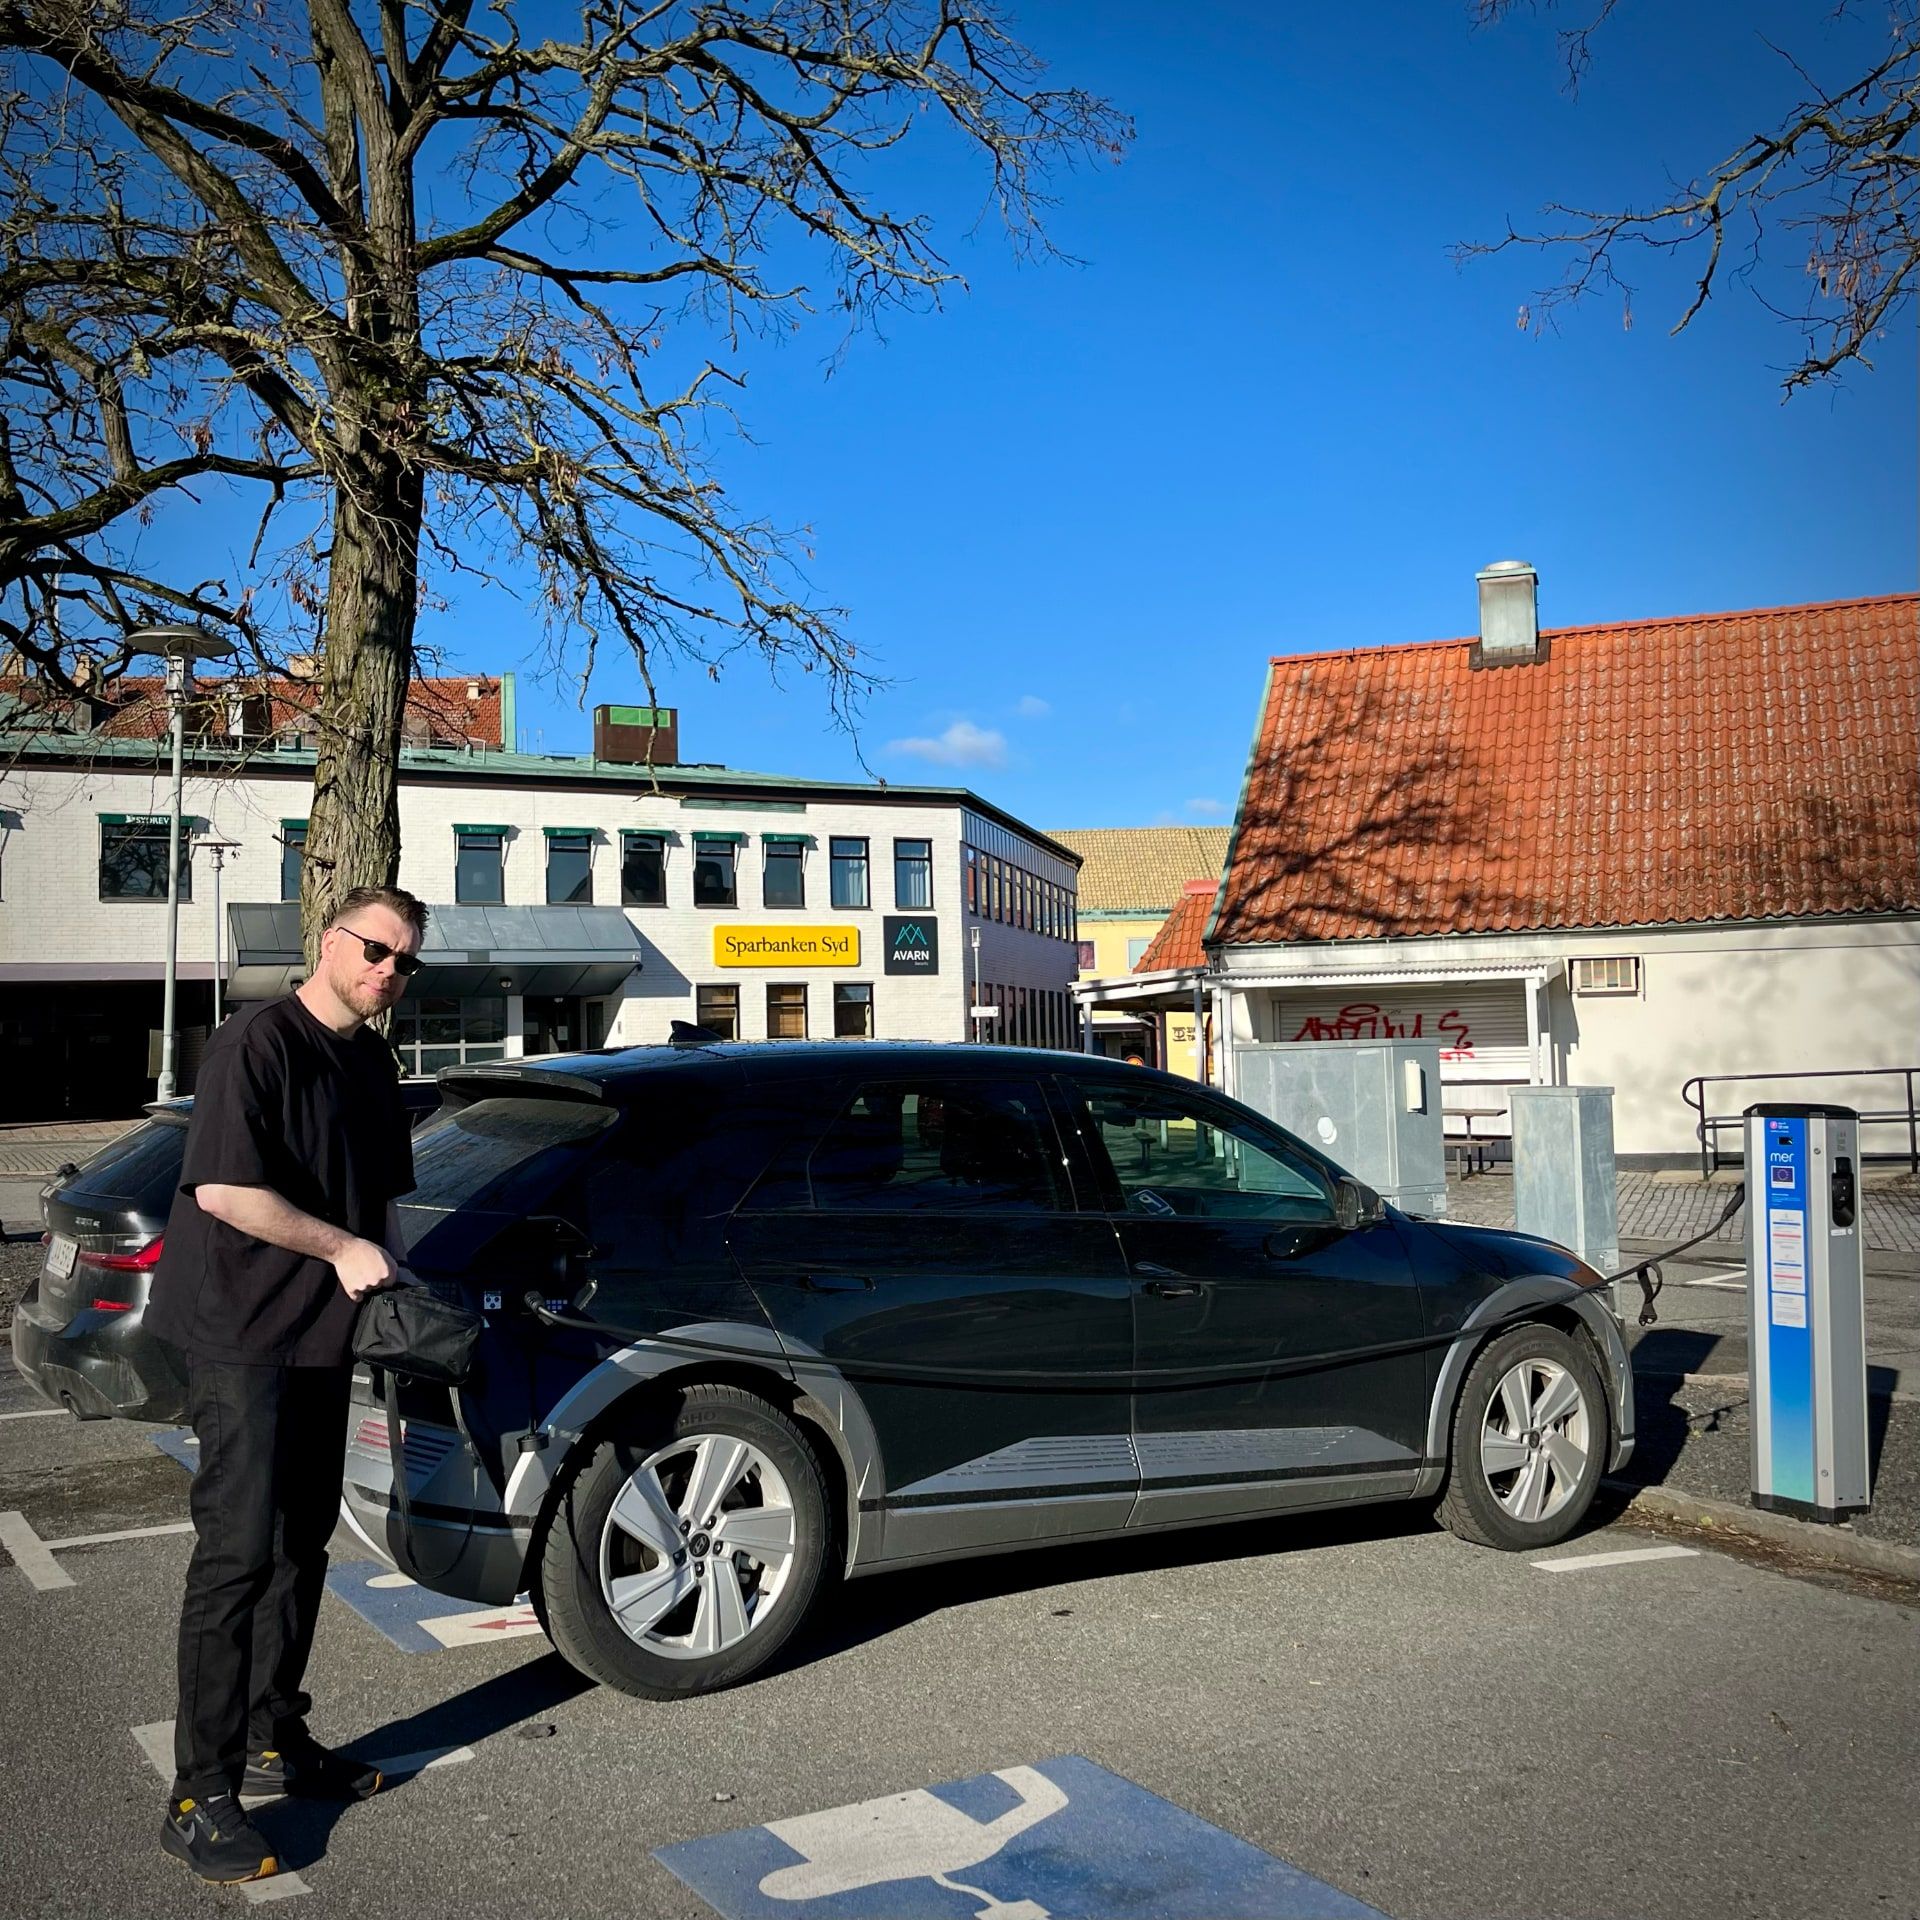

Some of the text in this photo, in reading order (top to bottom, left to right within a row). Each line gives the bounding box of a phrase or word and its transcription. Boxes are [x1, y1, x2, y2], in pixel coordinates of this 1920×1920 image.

[725, 936, 849, 957] Sparbanken Syd
[893, 950, 930, 961] AVARN
[1770, 1152, 1795, 1163] mer
